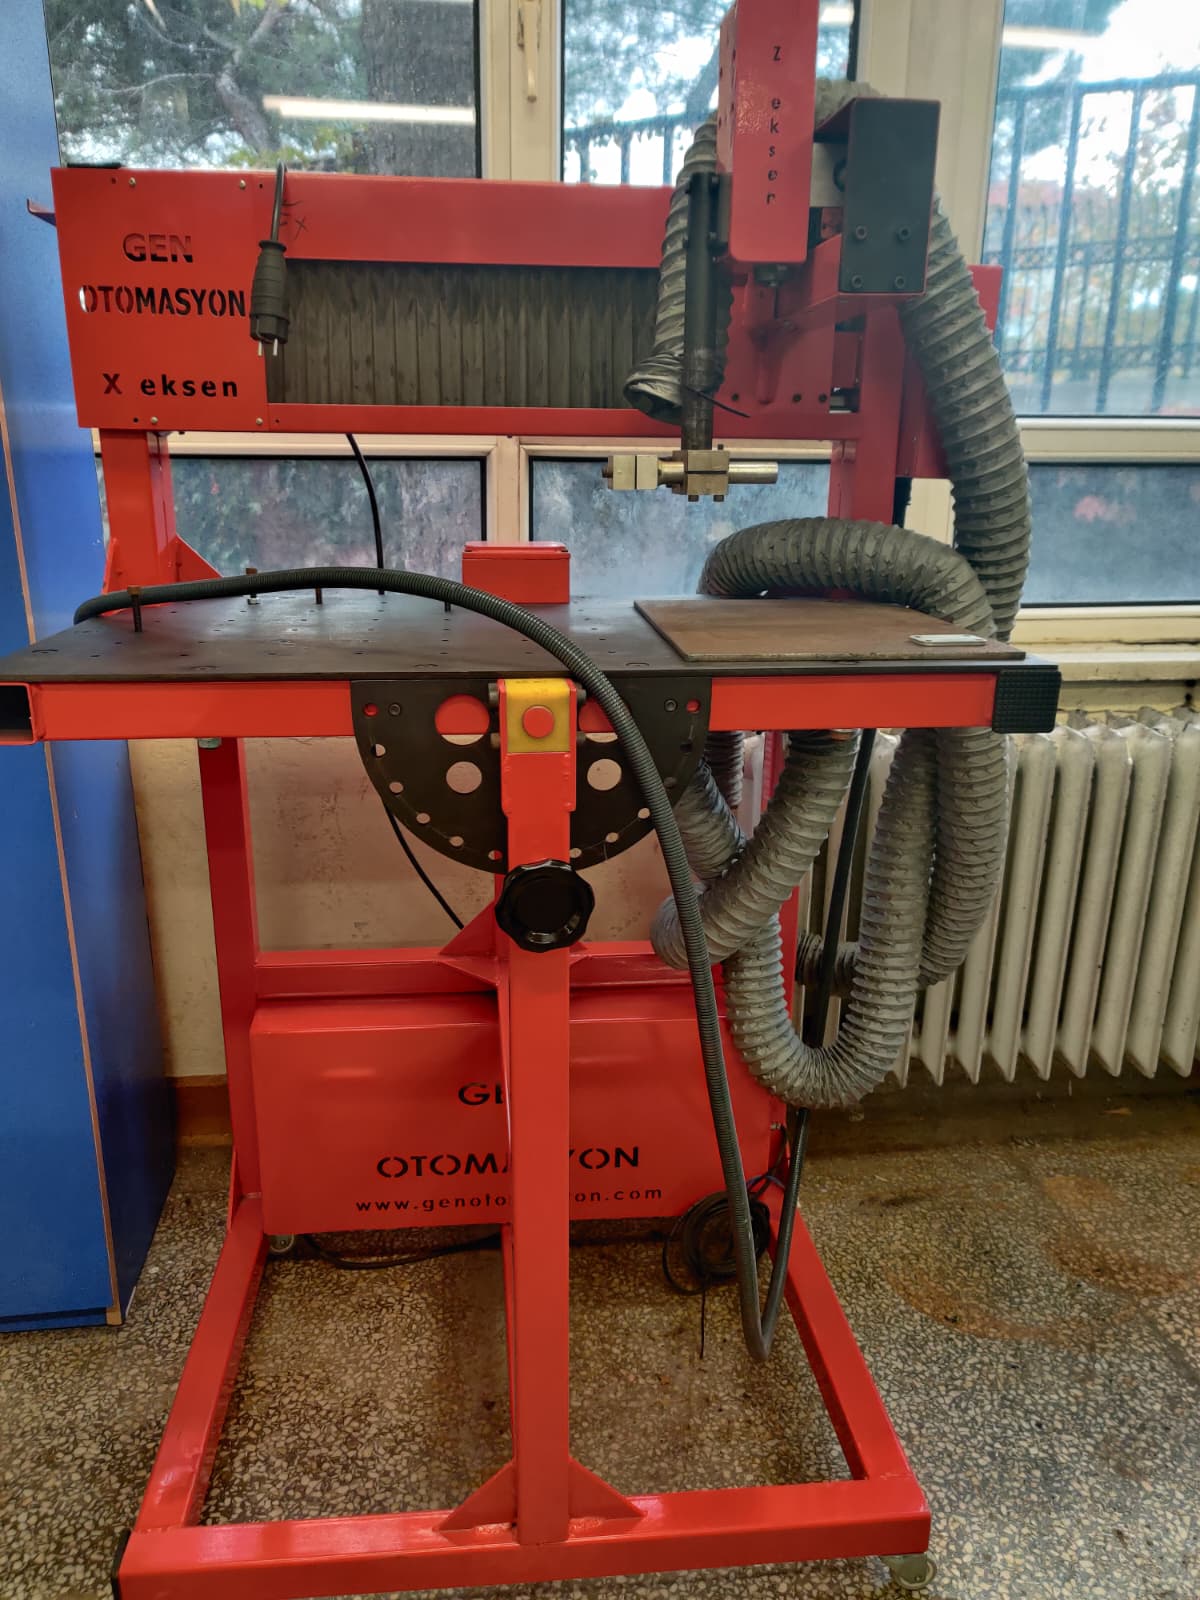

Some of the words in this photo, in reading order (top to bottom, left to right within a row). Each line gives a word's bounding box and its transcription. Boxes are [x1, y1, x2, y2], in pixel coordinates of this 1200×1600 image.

[772, 45, 783, 62] Z
[122, 232, 194, 263] GEN
[78, 284, 247, 318] OTOMASYON
[102, 373, 123, 395] X
[140, 374, 238, 398] eksen
